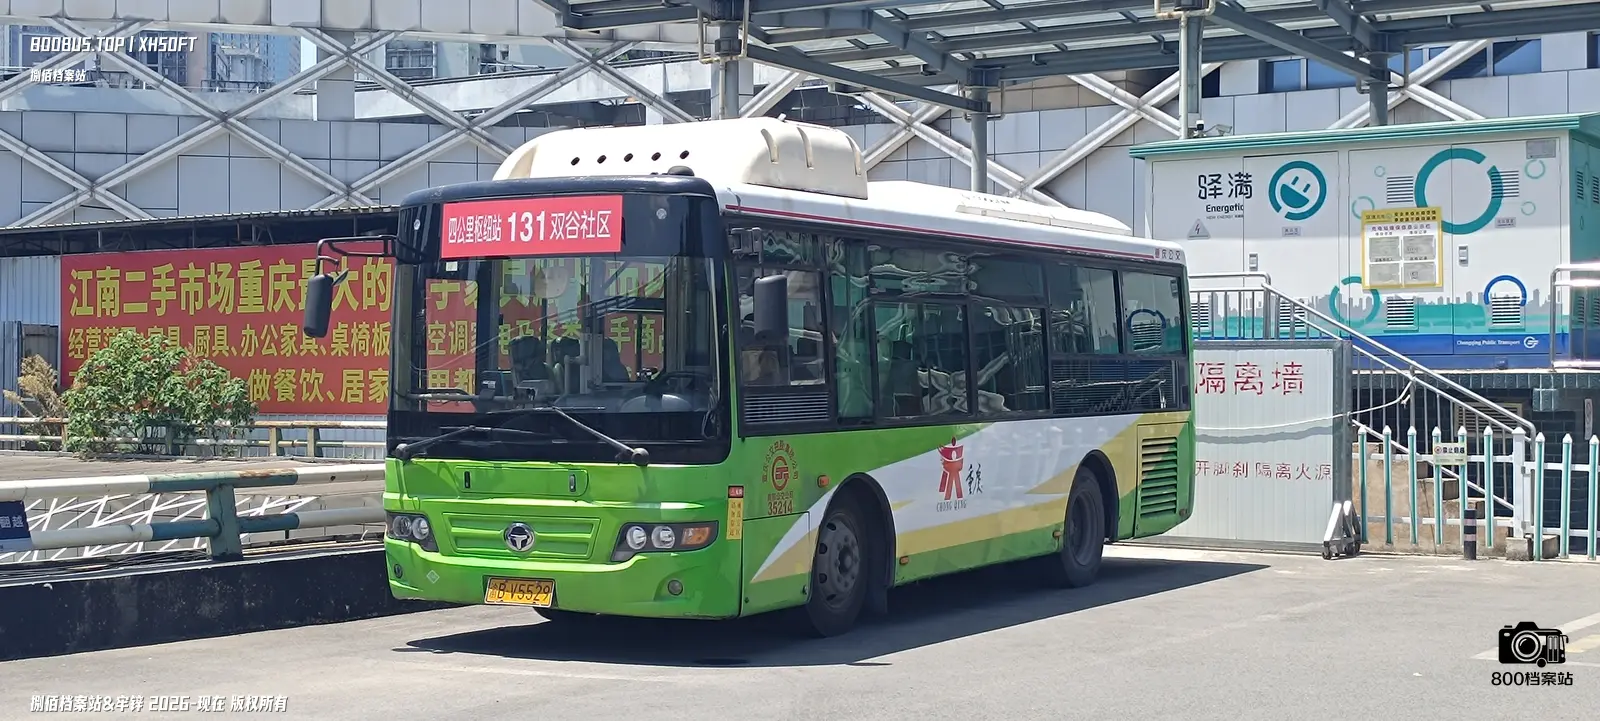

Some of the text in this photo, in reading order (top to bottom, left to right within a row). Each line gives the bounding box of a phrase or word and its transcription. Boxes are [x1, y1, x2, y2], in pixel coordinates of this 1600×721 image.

[1198, 172, 1253, 199] 驿满
[448, 209, 612, 244] 四公里枢纽站 131 双谷社区
[1195, 362, 1303, 395] 隔离墙
[767, 500, 794, 515] 35214
